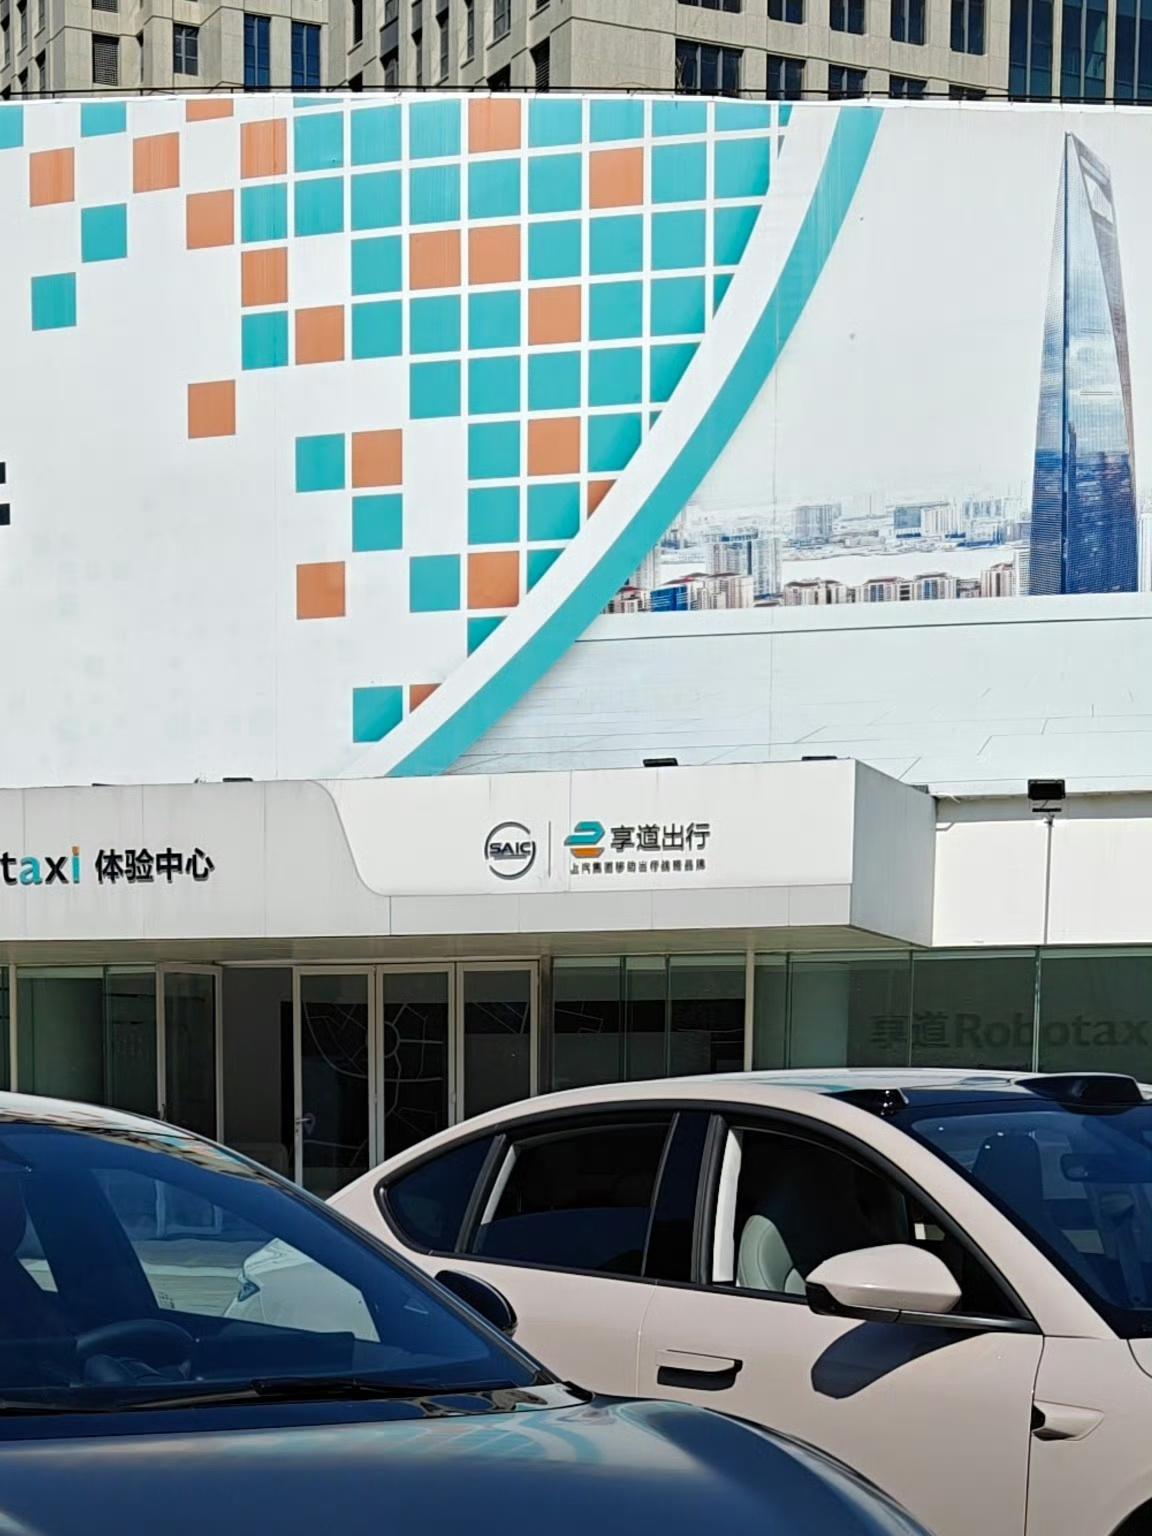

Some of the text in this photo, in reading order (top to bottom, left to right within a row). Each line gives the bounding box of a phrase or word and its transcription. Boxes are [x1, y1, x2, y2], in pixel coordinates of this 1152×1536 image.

[489, 841, 533, 857] SAIC
[610, 822, 710, 852] 享道出行
[95, 847, 215, 884] 体验中心
